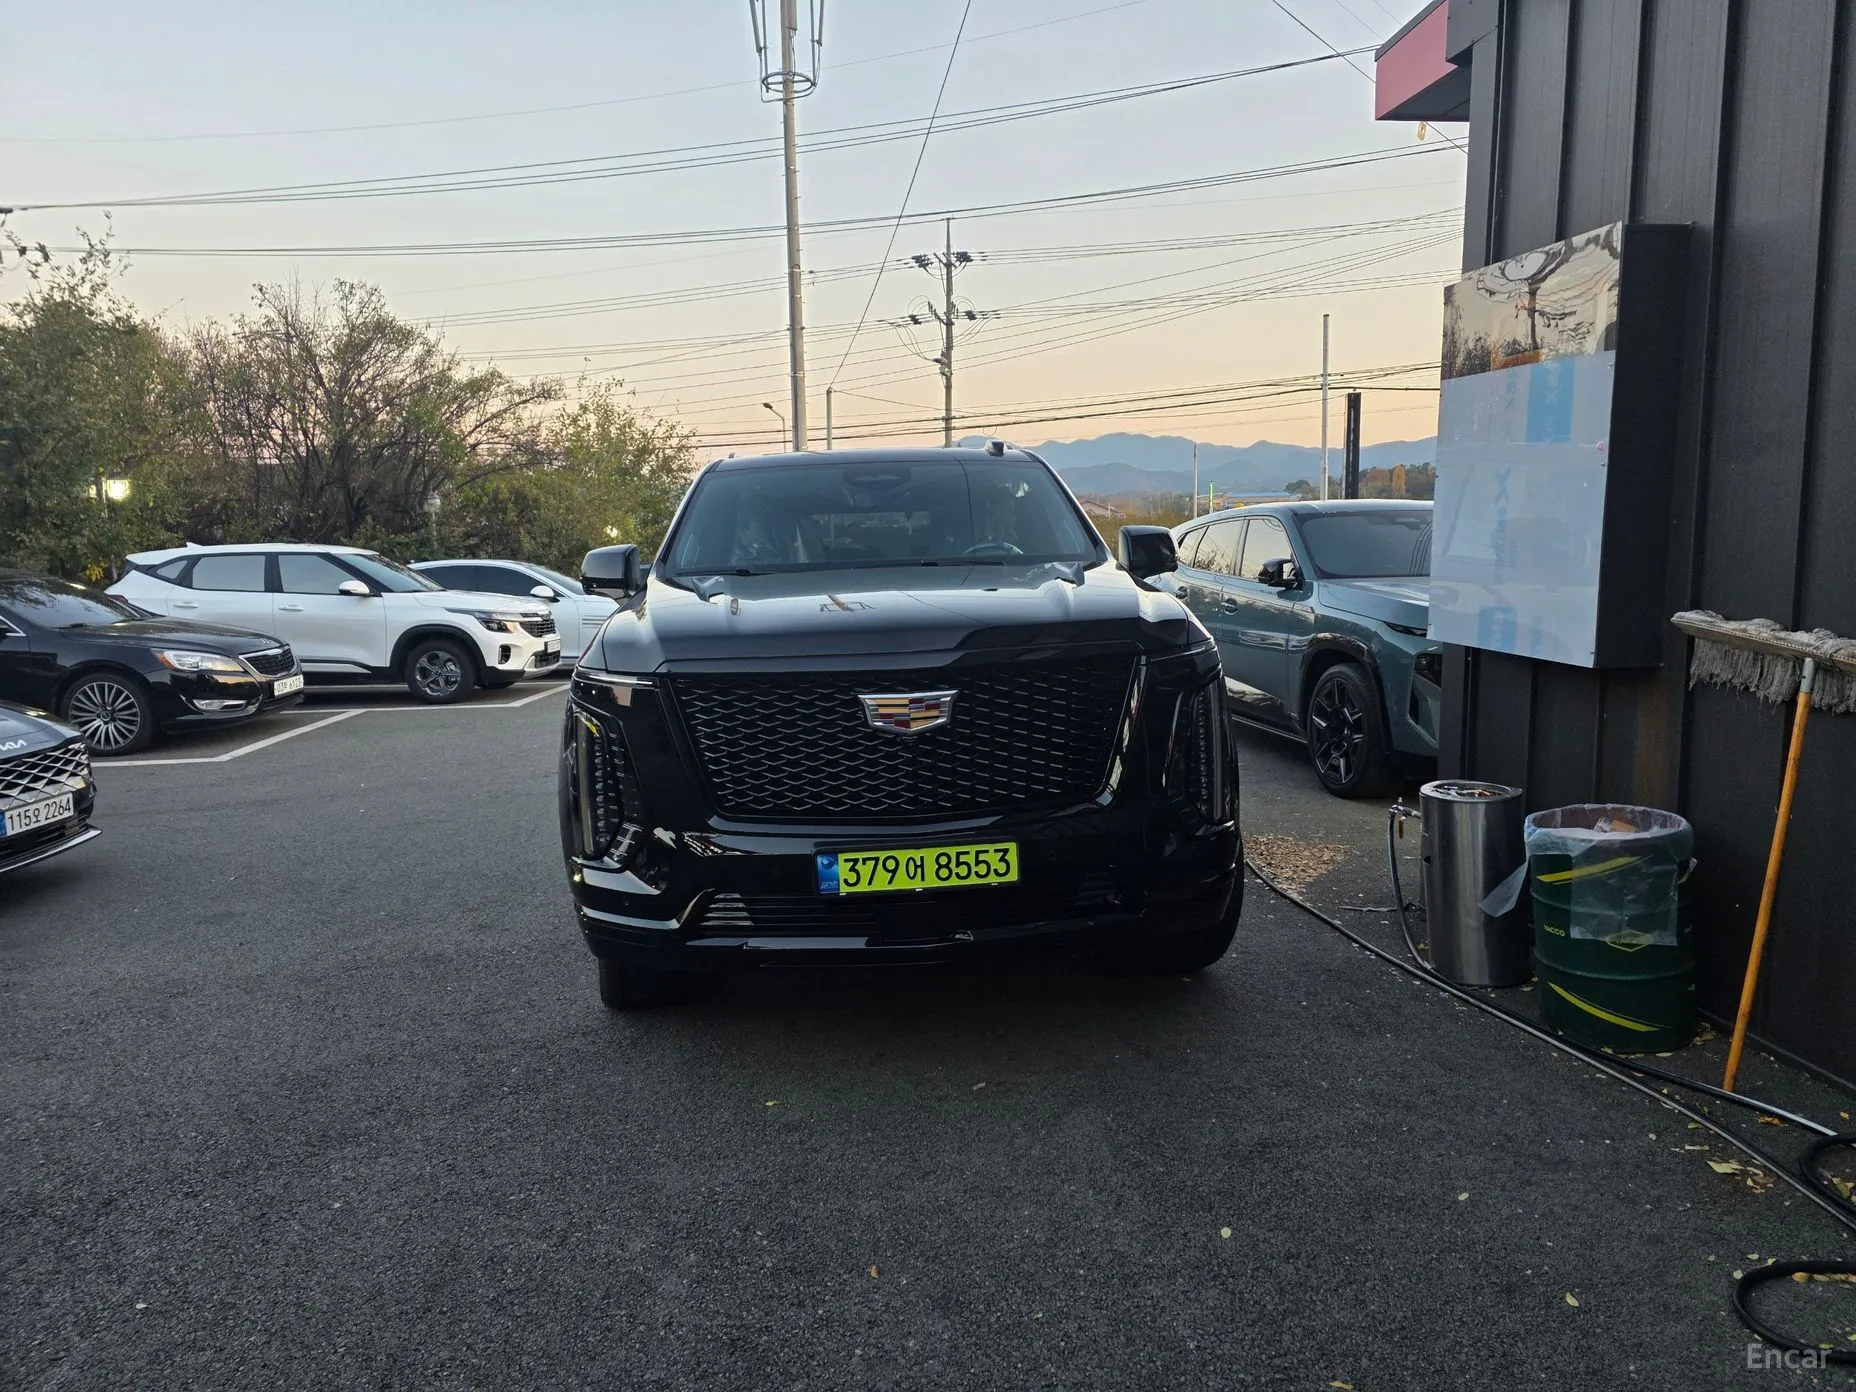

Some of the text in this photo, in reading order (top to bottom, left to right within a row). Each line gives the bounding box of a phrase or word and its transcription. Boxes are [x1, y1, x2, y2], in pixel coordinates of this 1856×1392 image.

[44, 797, 71, 820] 2264
[843, 848, 1010, 887] 379어 8553
